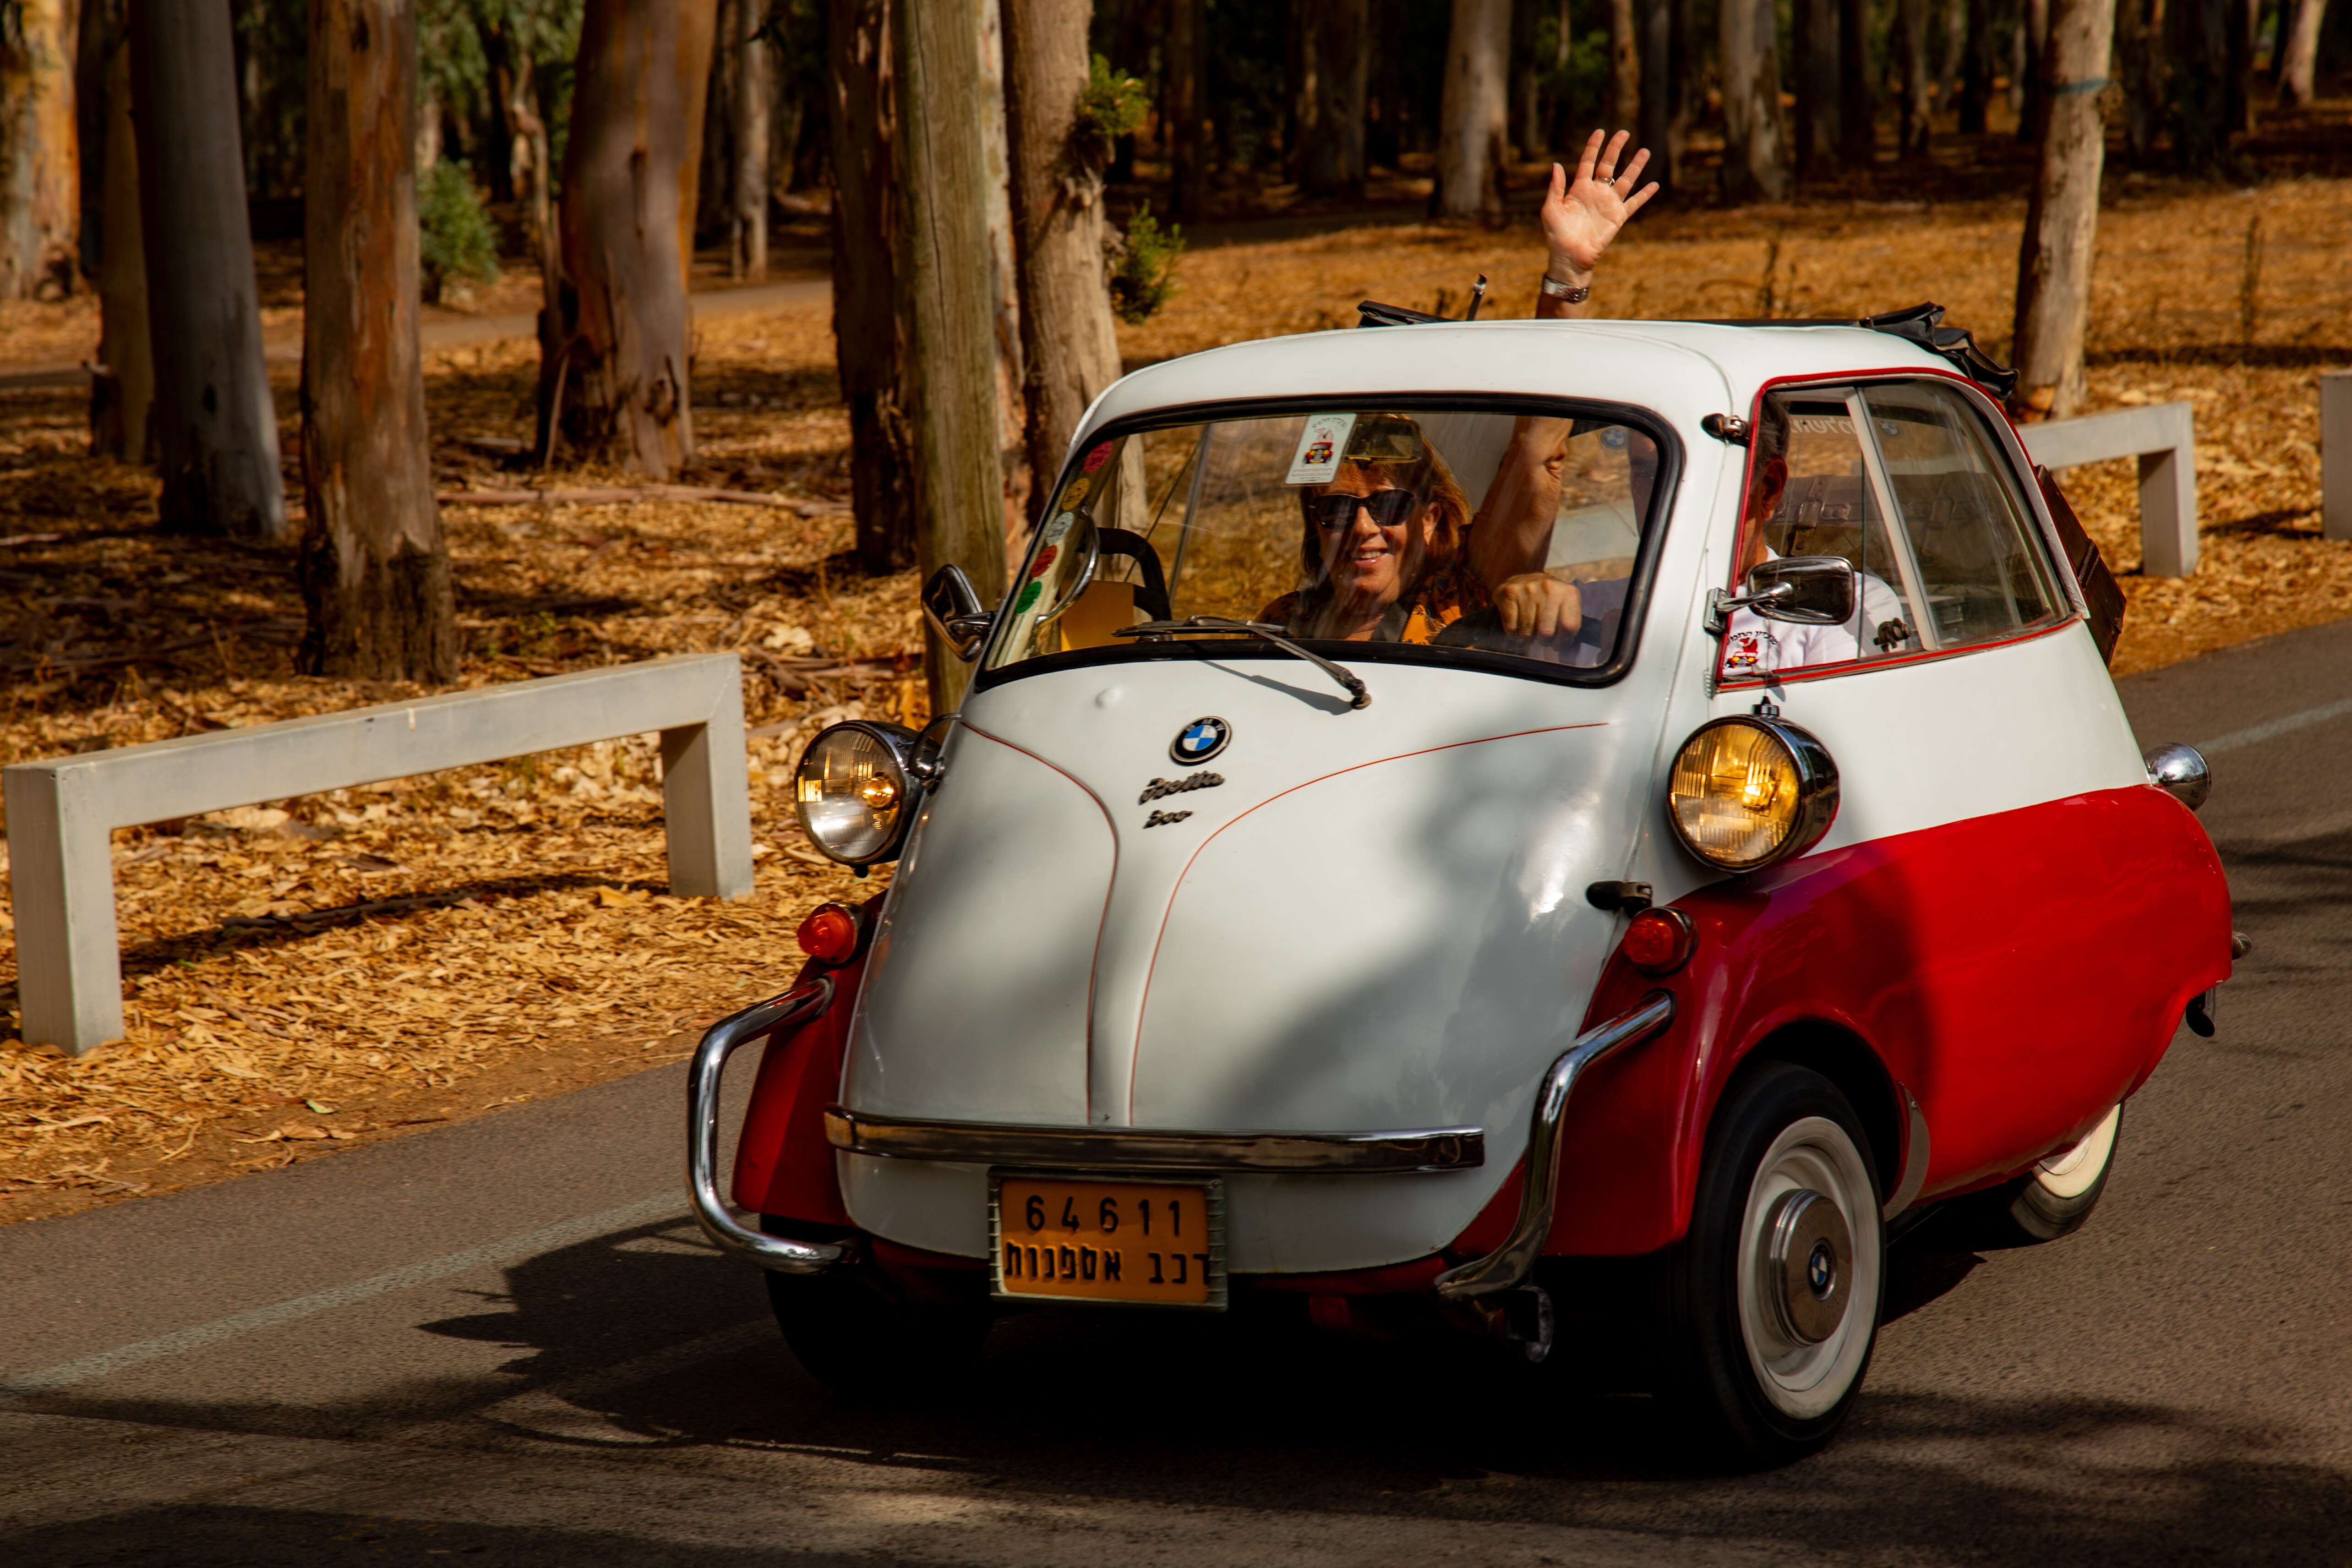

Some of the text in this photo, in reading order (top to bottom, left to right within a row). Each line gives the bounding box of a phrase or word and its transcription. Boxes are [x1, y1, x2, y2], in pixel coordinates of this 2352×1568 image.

[1026, 1194, 1180, 1236] 64611
[1004, 1241, 1210, 1285] רכב אספנות
